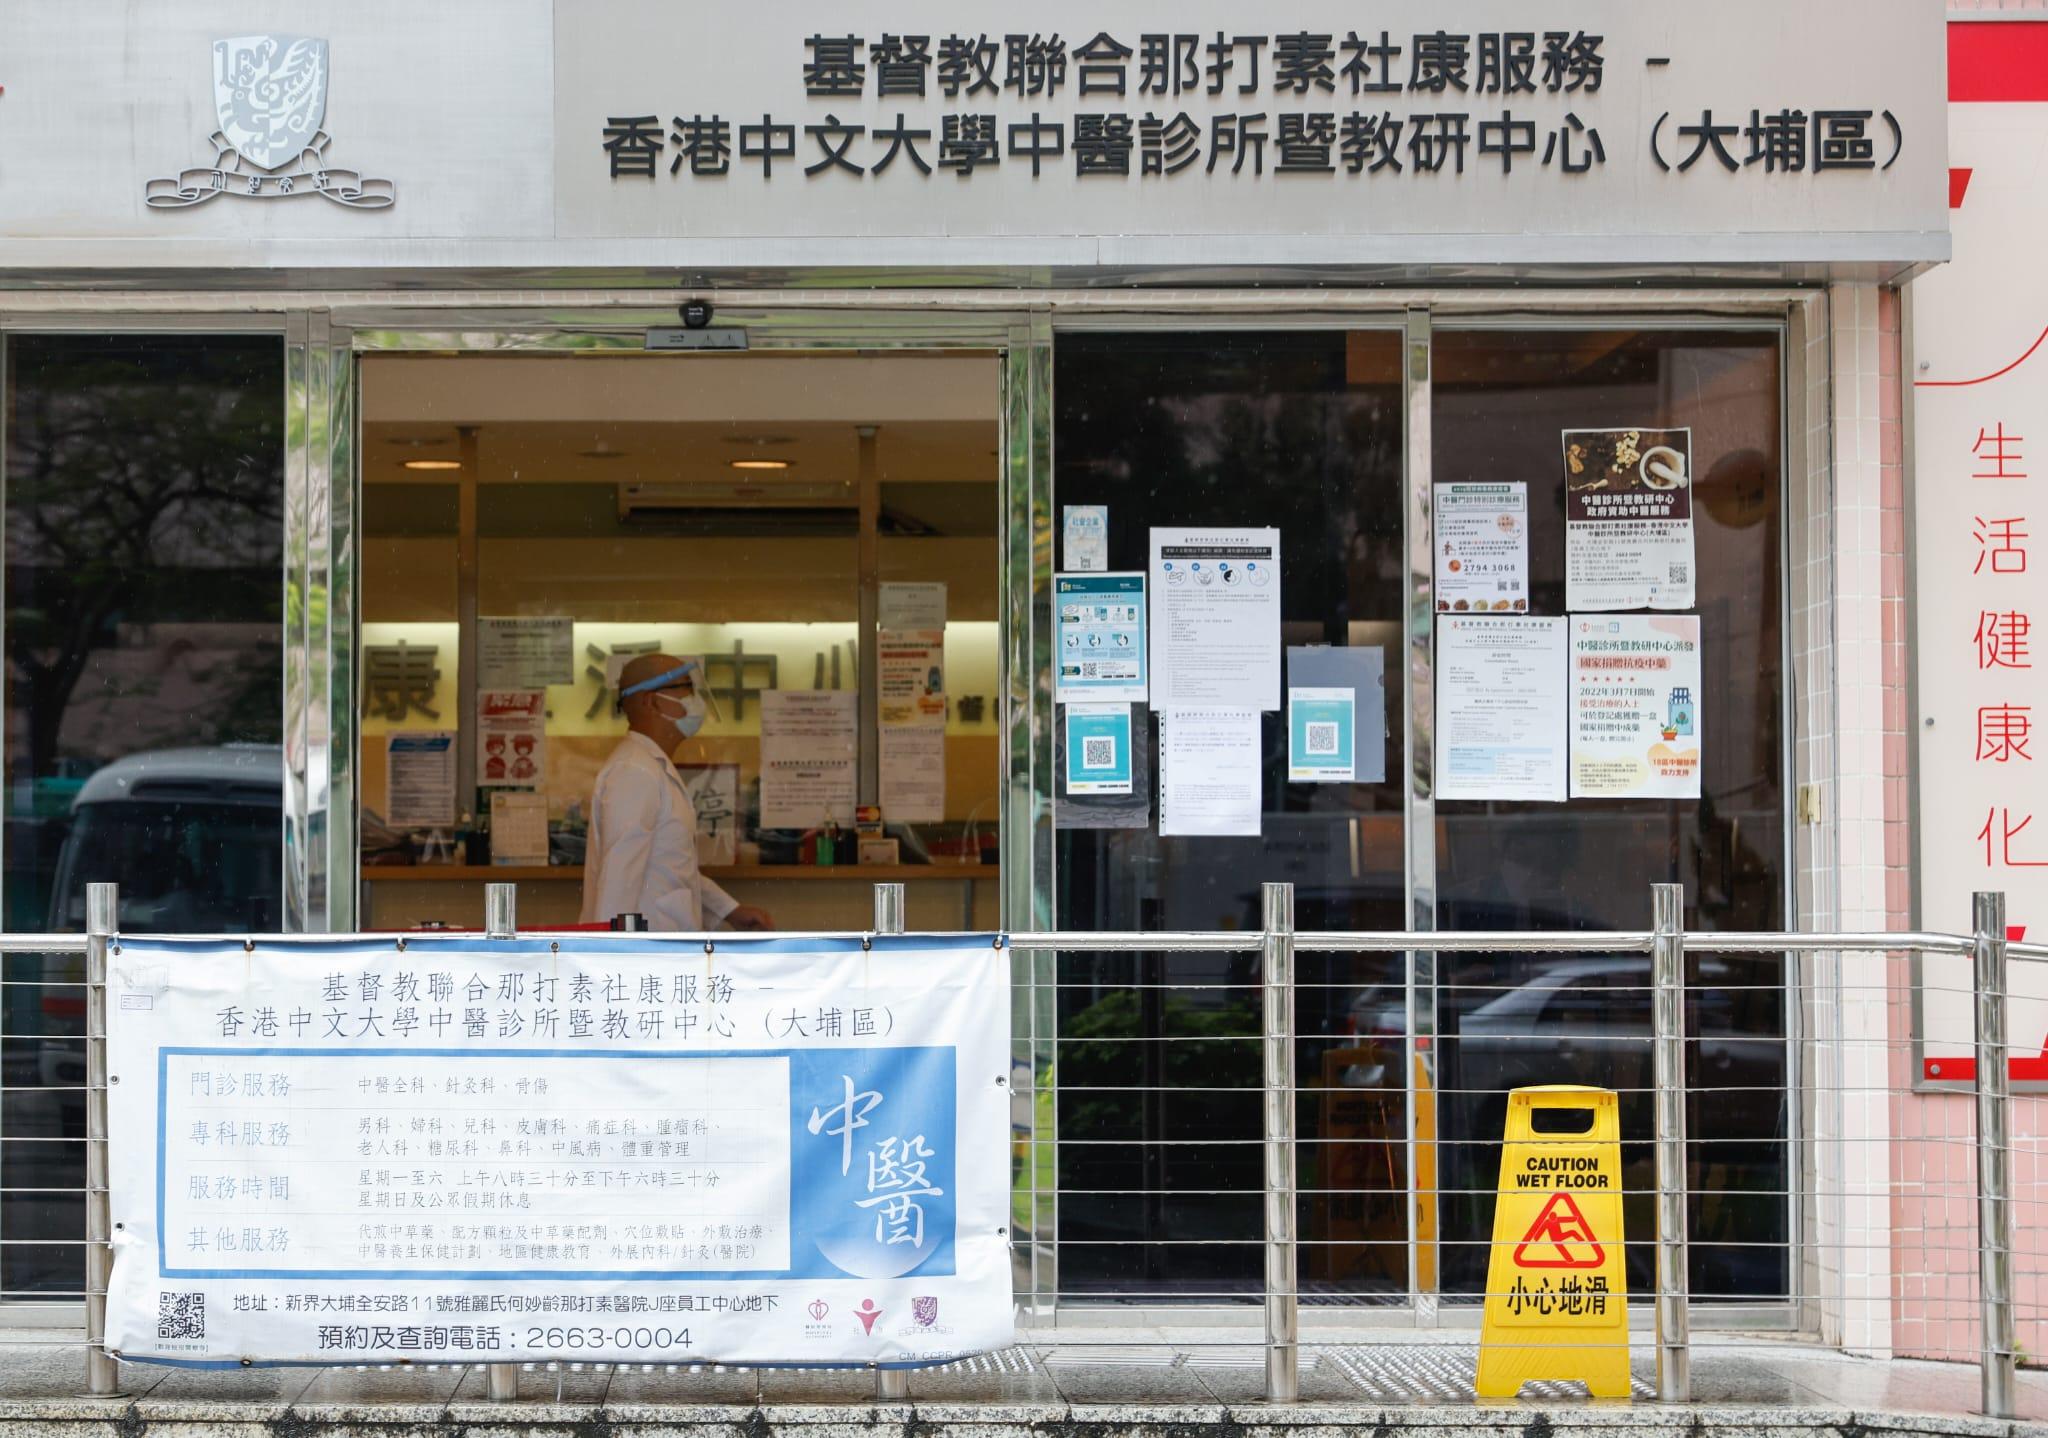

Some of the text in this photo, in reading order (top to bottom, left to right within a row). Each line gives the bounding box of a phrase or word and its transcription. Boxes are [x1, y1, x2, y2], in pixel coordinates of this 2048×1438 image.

[803, 31, 1604, 98] 基督教聯合那打素社康服務
[1581, 494, 1675, 506] 中醫診所暨教研中心
[1586, 505, 1671, 517] 政府資助中醫服務
[1577, 640, 1694, 652] 中醫診所暨教研中心派發
[1580, 657, 1667, 669] 國家捐贈抗疫中藥
[1579, 687, 1655, 697] 2022年3月7日開始
[1579, 699, 1640, 708] 接受治療的人士
[1580, 723, 1640, 732] 國家捐贈中成藥
[322, 971, 736, 1003] 基督教聯合那打素社康服務
[191, 1072, 293, 1097] 門診服務
[189, 1121, 292, 1147] 專科服務
[807, 1074, 944, 1249] 中醫
[1526, 1157, 1599, 1171] CAUTION
[358, 1168, 721, 1188] 星期一至六 上午八時三十分至下午六時三十分
[1516, 1174, 1609, 1188] WET FLOOR
[188, 1175, 290, 1201] 服務時間
[358, 1191, 532, 1209] 星期日及公眾假期休息
[187, 1226, 290, 1253] 其他服務
[1507, 1275, 1609, 1316] 小心地滑
